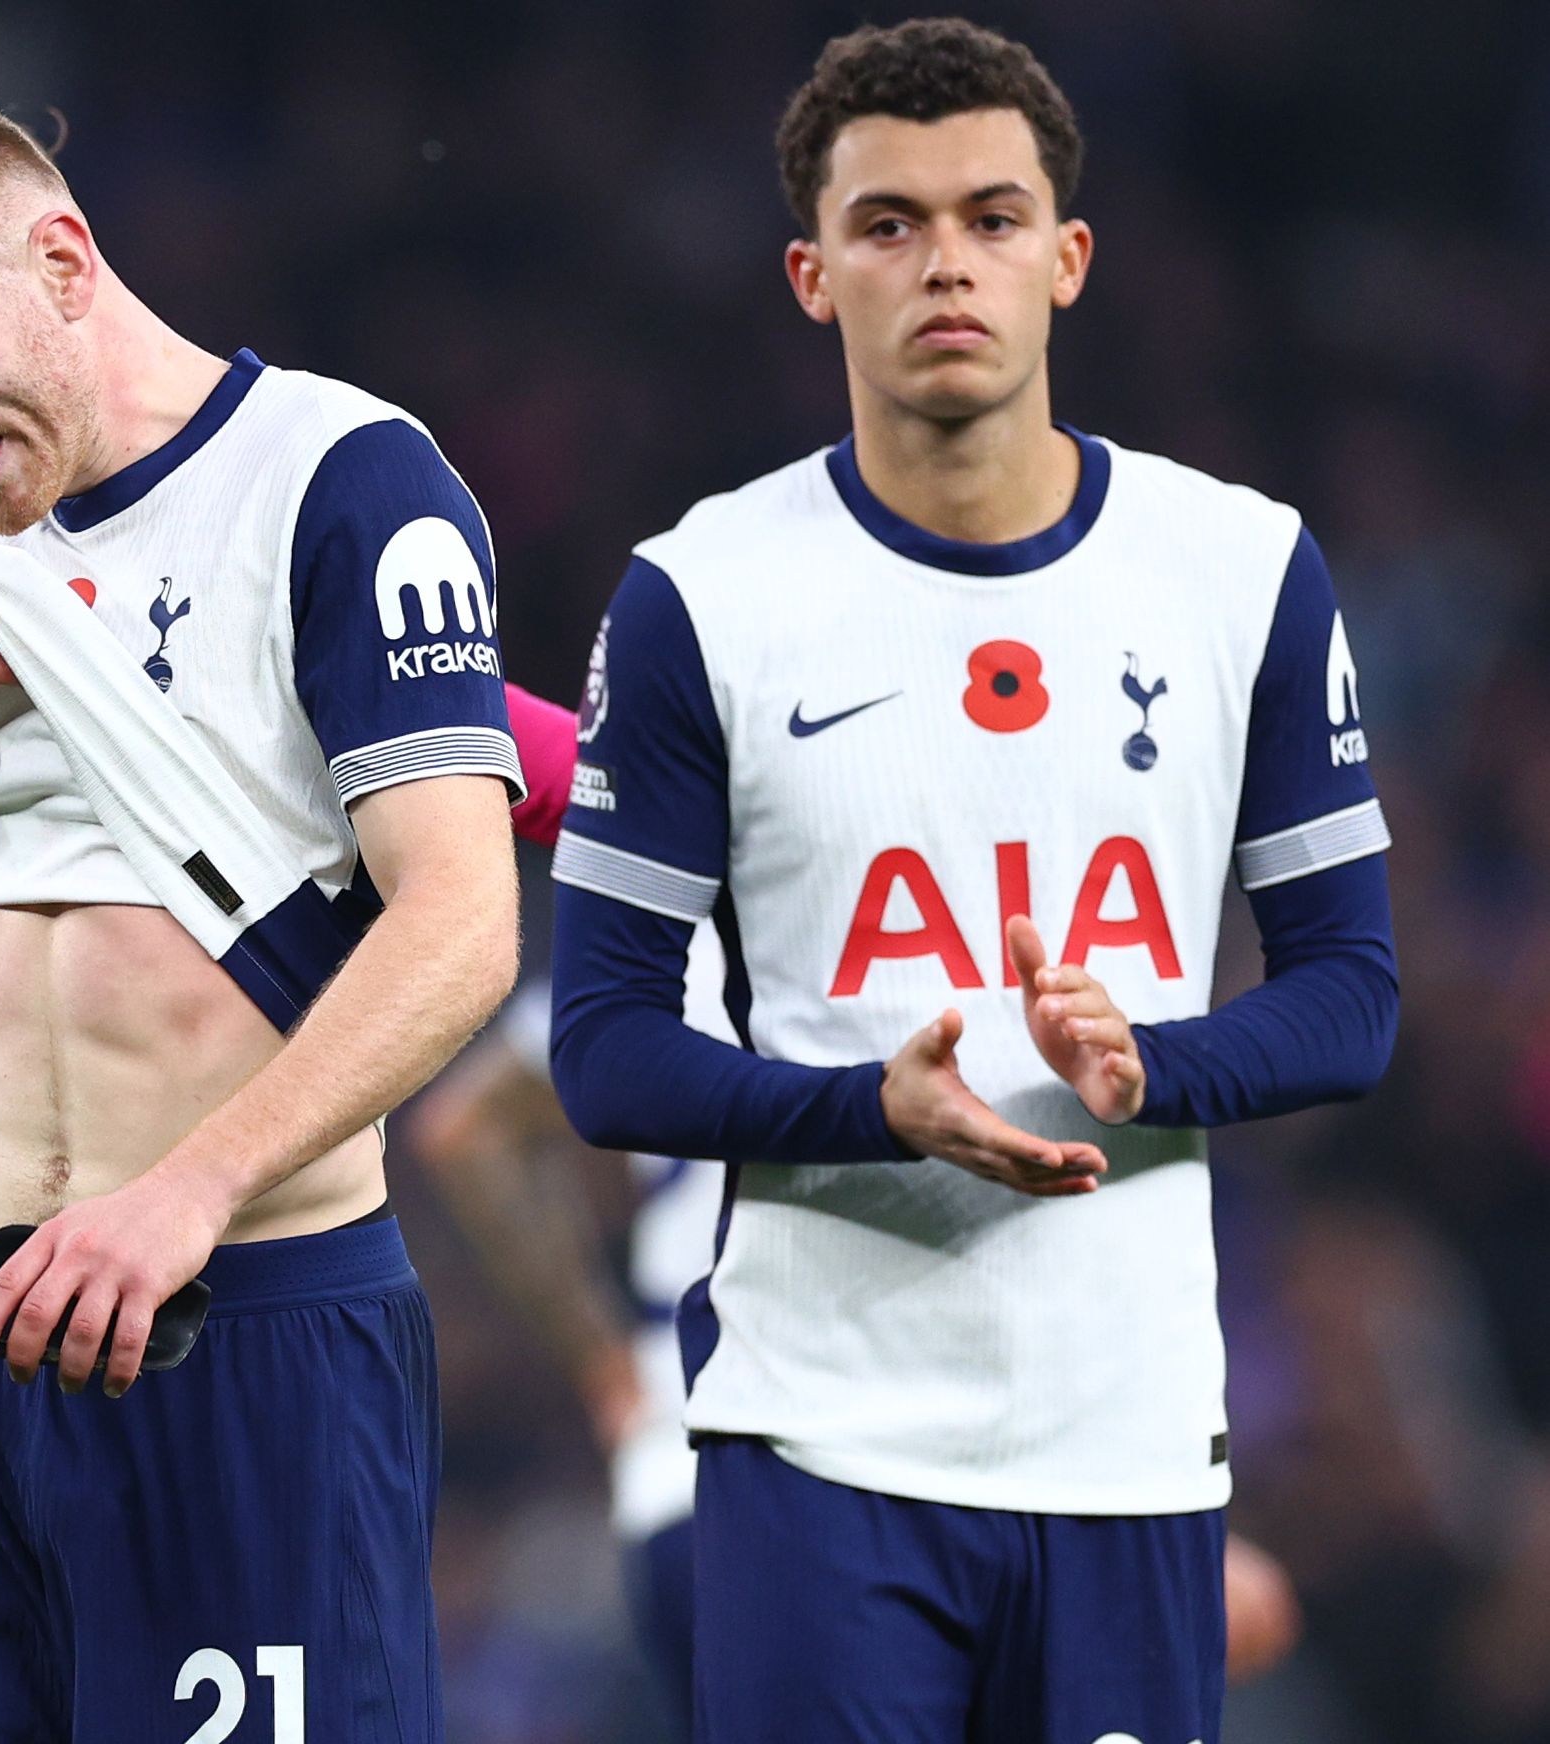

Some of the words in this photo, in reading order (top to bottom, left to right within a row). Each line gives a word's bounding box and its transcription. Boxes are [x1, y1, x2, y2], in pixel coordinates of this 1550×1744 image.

[386, 641, 501, 681] kraken
[826, 834, 1185, 998] AIA
[173, 1644, 305, 1744] 21
